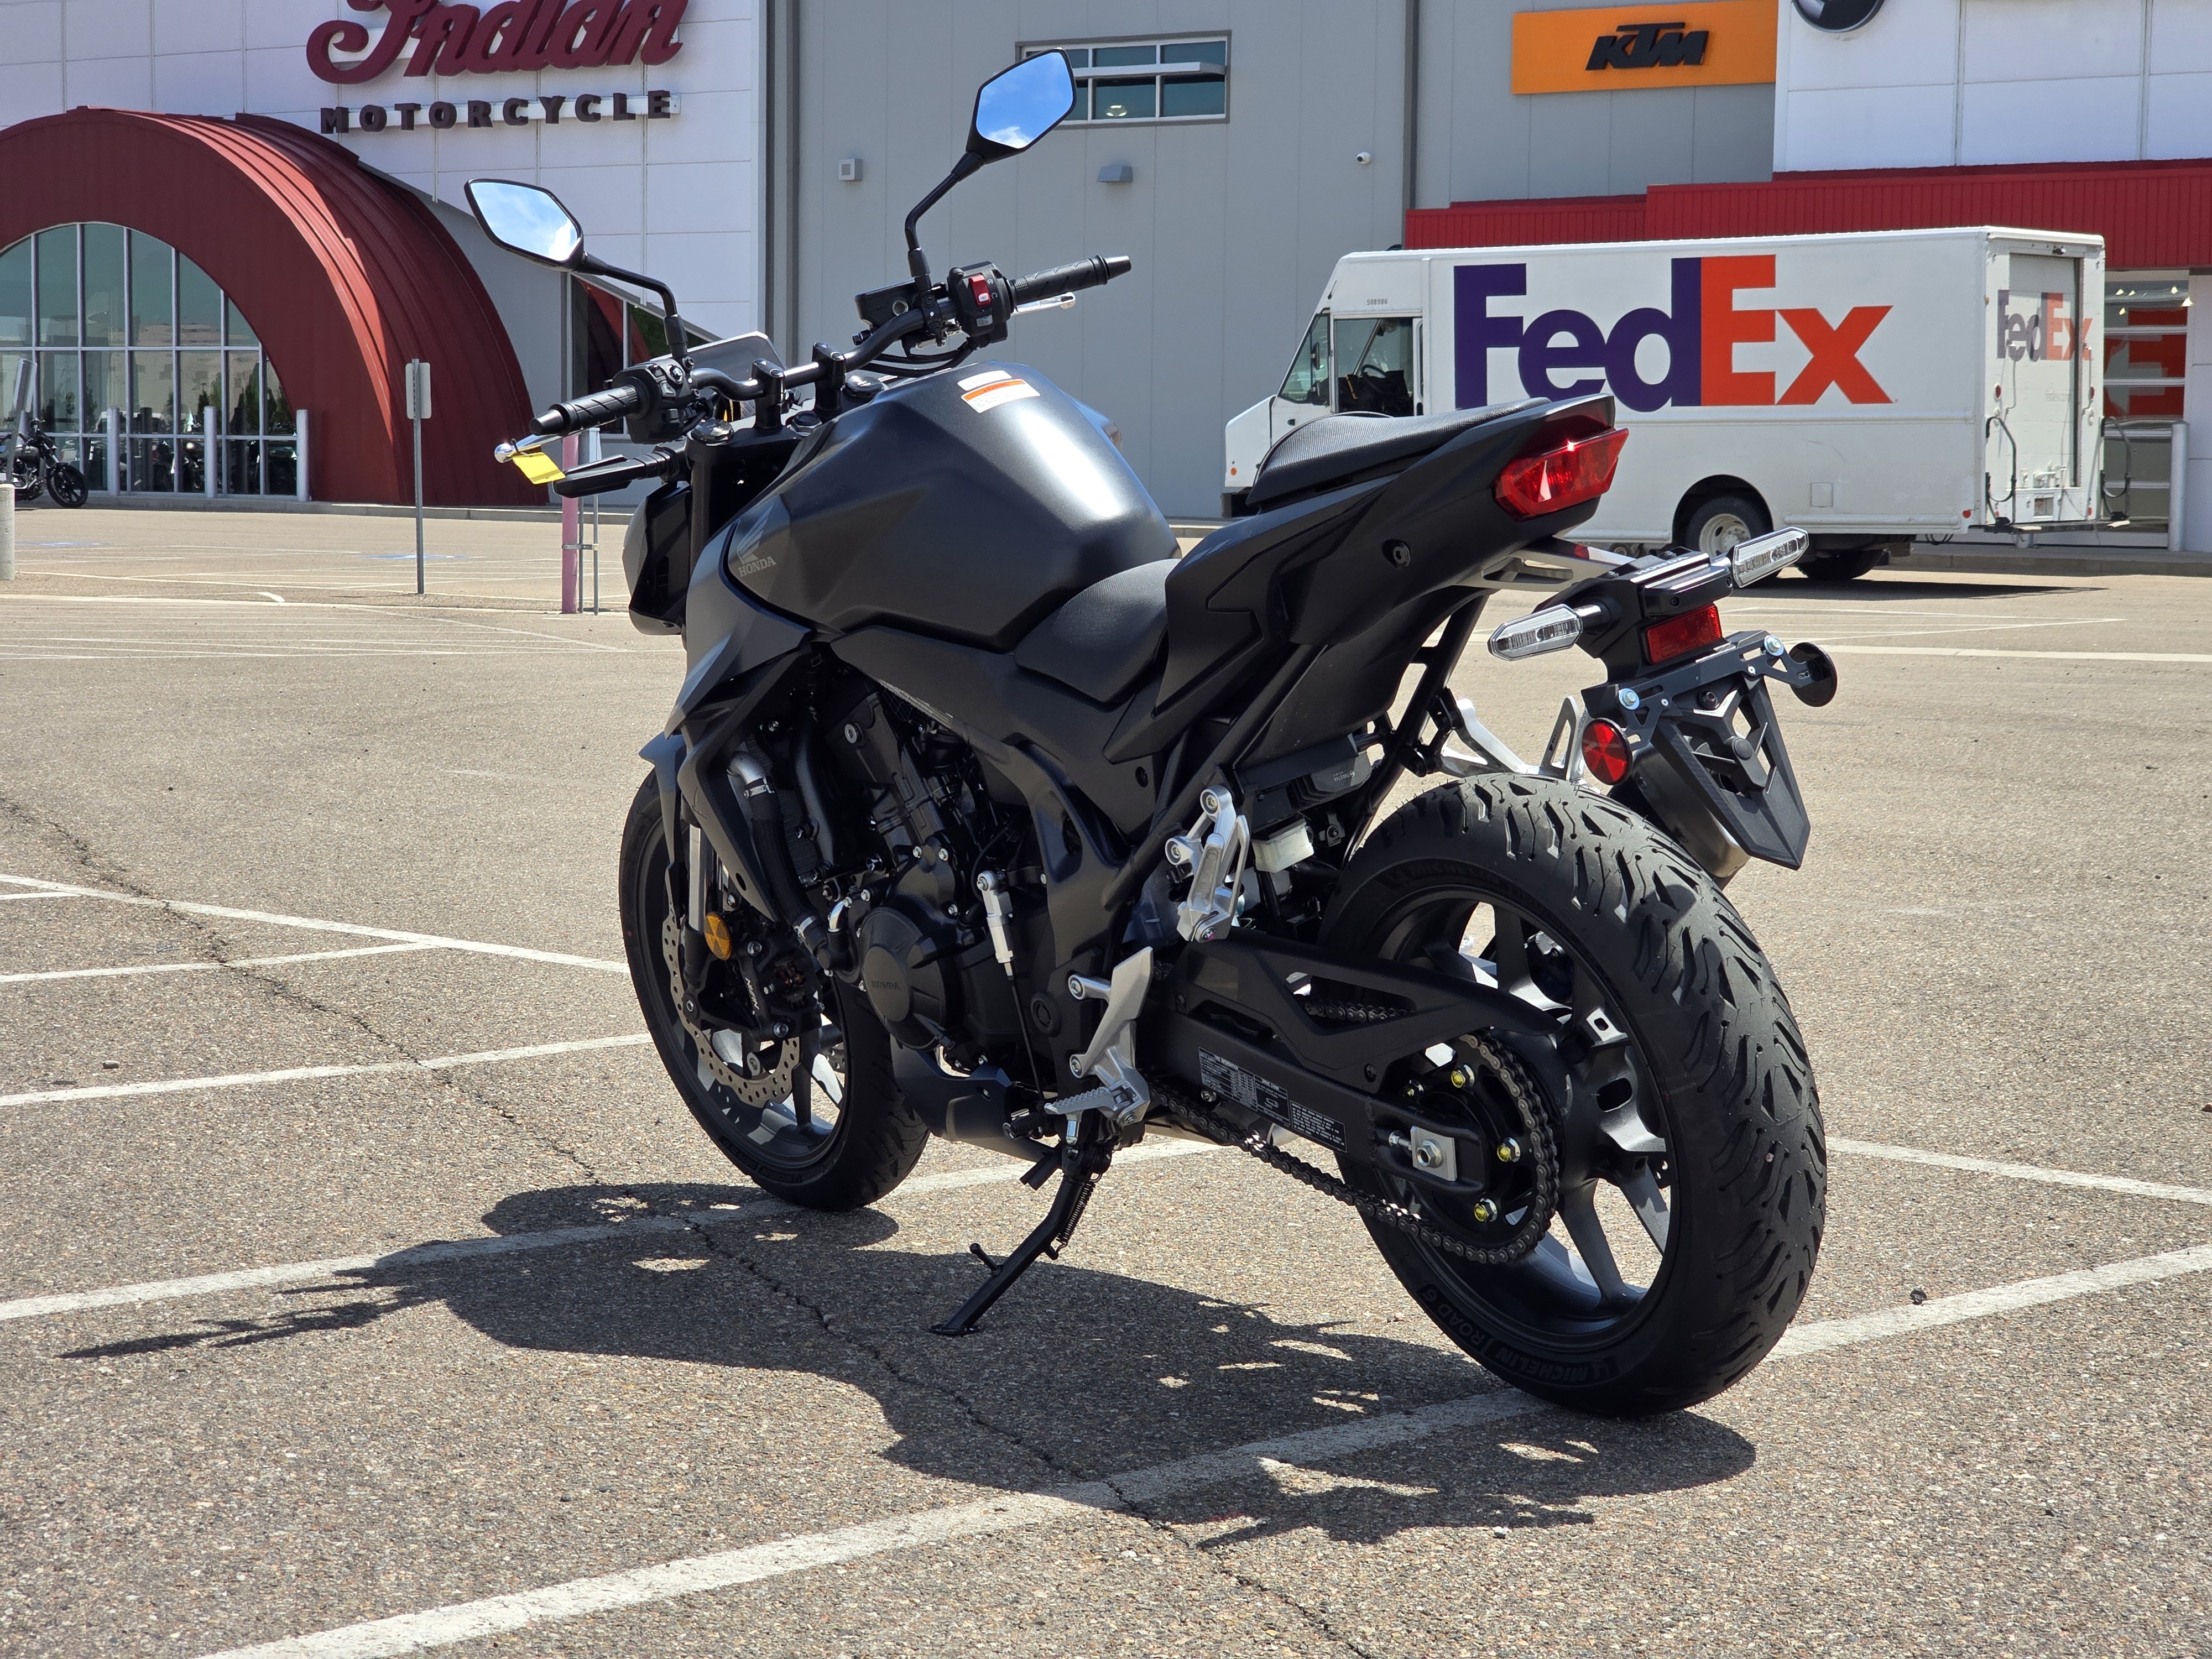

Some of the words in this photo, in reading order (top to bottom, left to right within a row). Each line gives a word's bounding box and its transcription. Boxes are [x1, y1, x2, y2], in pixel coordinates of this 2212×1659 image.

[306, 0, 683, 84] Indian
[1585, 22, 1709, 70] KTM
[320, 90, 671, 134] MOTORCYCLE
[1454, 254, 1893, 412] FedEx
[1997, 290, 2093, 362] FedEx
[738, 556, 776, 577] HONDA
[1633, 556, 1691, 575] HONDA
[872, 980, 900, 990] HONDA
[1421, 1287, 1438, 1303] 6
[1437, 1302, 1485, 1345] ROAD
[1494, 1347, 1588, 1381] MICHELIN
